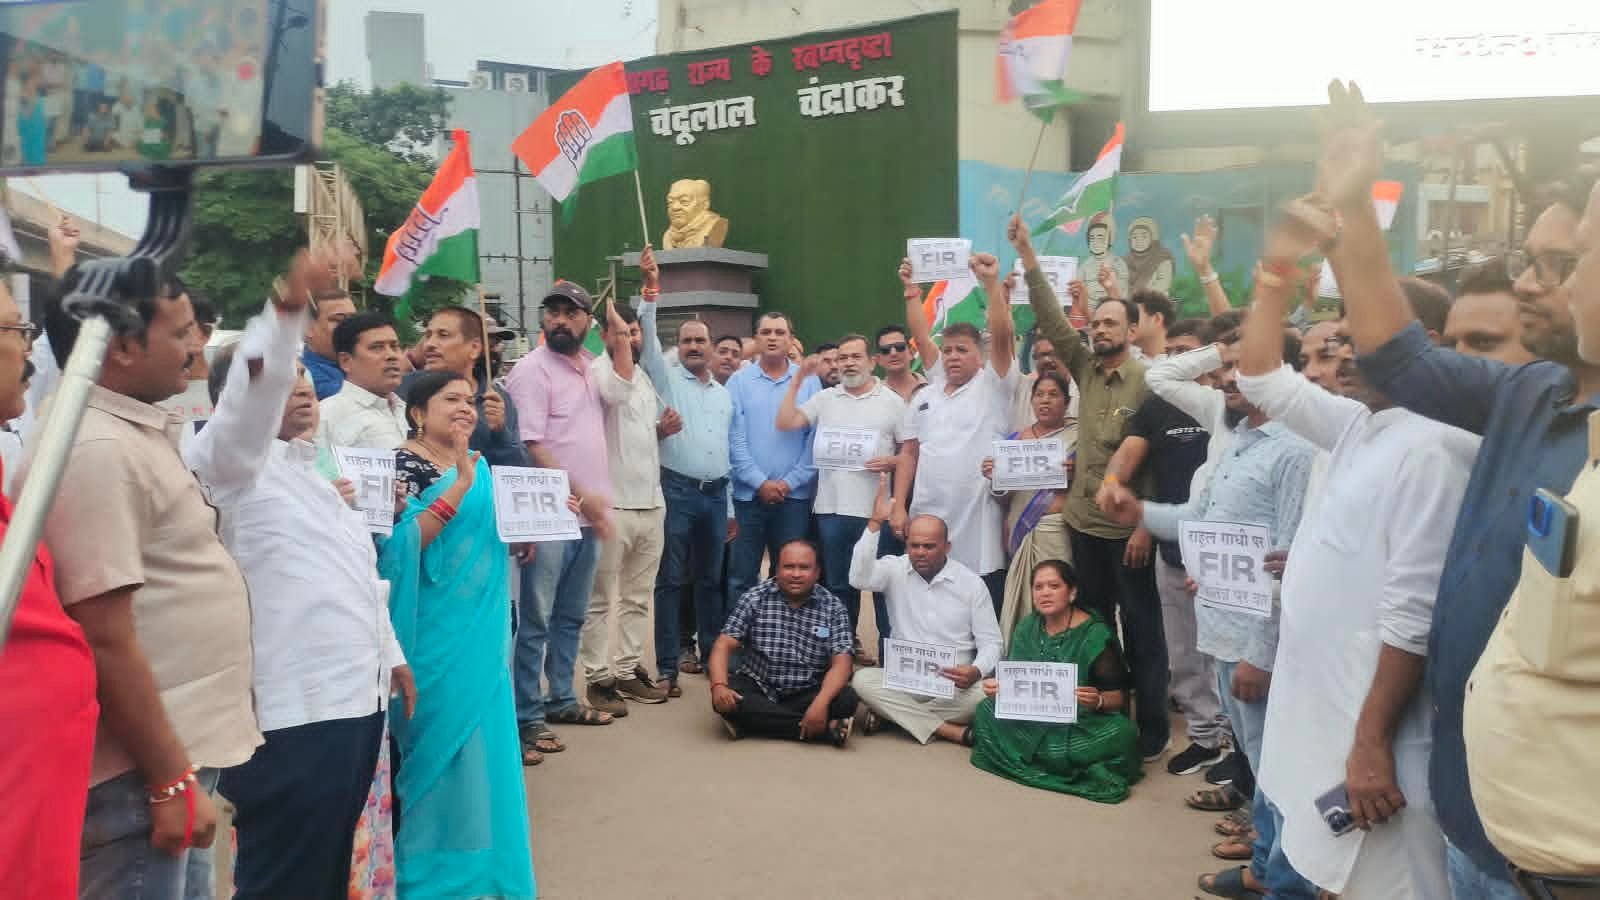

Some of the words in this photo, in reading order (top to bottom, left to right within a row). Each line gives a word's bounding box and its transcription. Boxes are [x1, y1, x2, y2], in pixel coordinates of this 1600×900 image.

[688, 58, 733, 87] राज्य
[752, 46, 773, 76] के
[797, 75, 905, 117] चंद्राकर
[921, 251, 956, 267] FIR
[826, 440, 864, 456] FIR
[1008, 456, 1051, 473] FIR
[360, 474, 394, 502] FI
[512, 491, 559, 514] FIR
[1200, 551, 1256, 583] FIR
[900, 657, 940, 676] FIR
[1014, 680, 1059, 700] FIR
